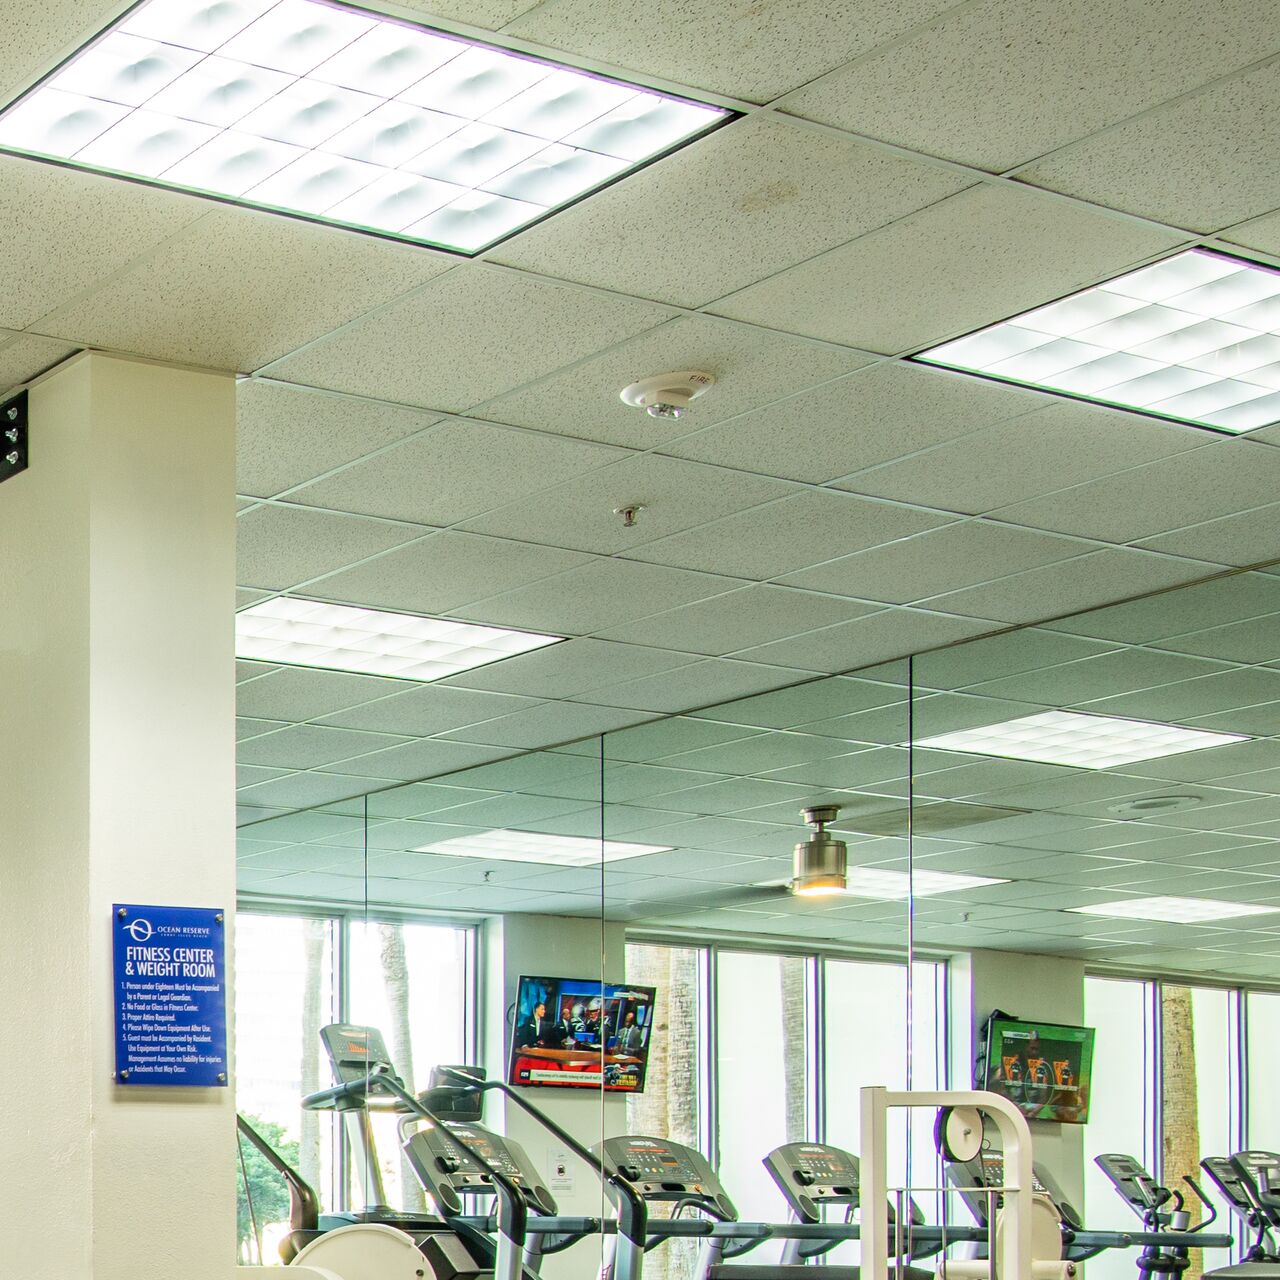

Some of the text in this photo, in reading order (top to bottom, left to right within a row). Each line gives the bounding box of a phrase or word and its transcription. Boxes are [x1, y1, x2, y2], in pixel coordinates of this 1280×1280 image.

[127, 947, 215, 964] FITNESS CENTER
[126, 961, 216, 978] & WEIGHT ROOM
